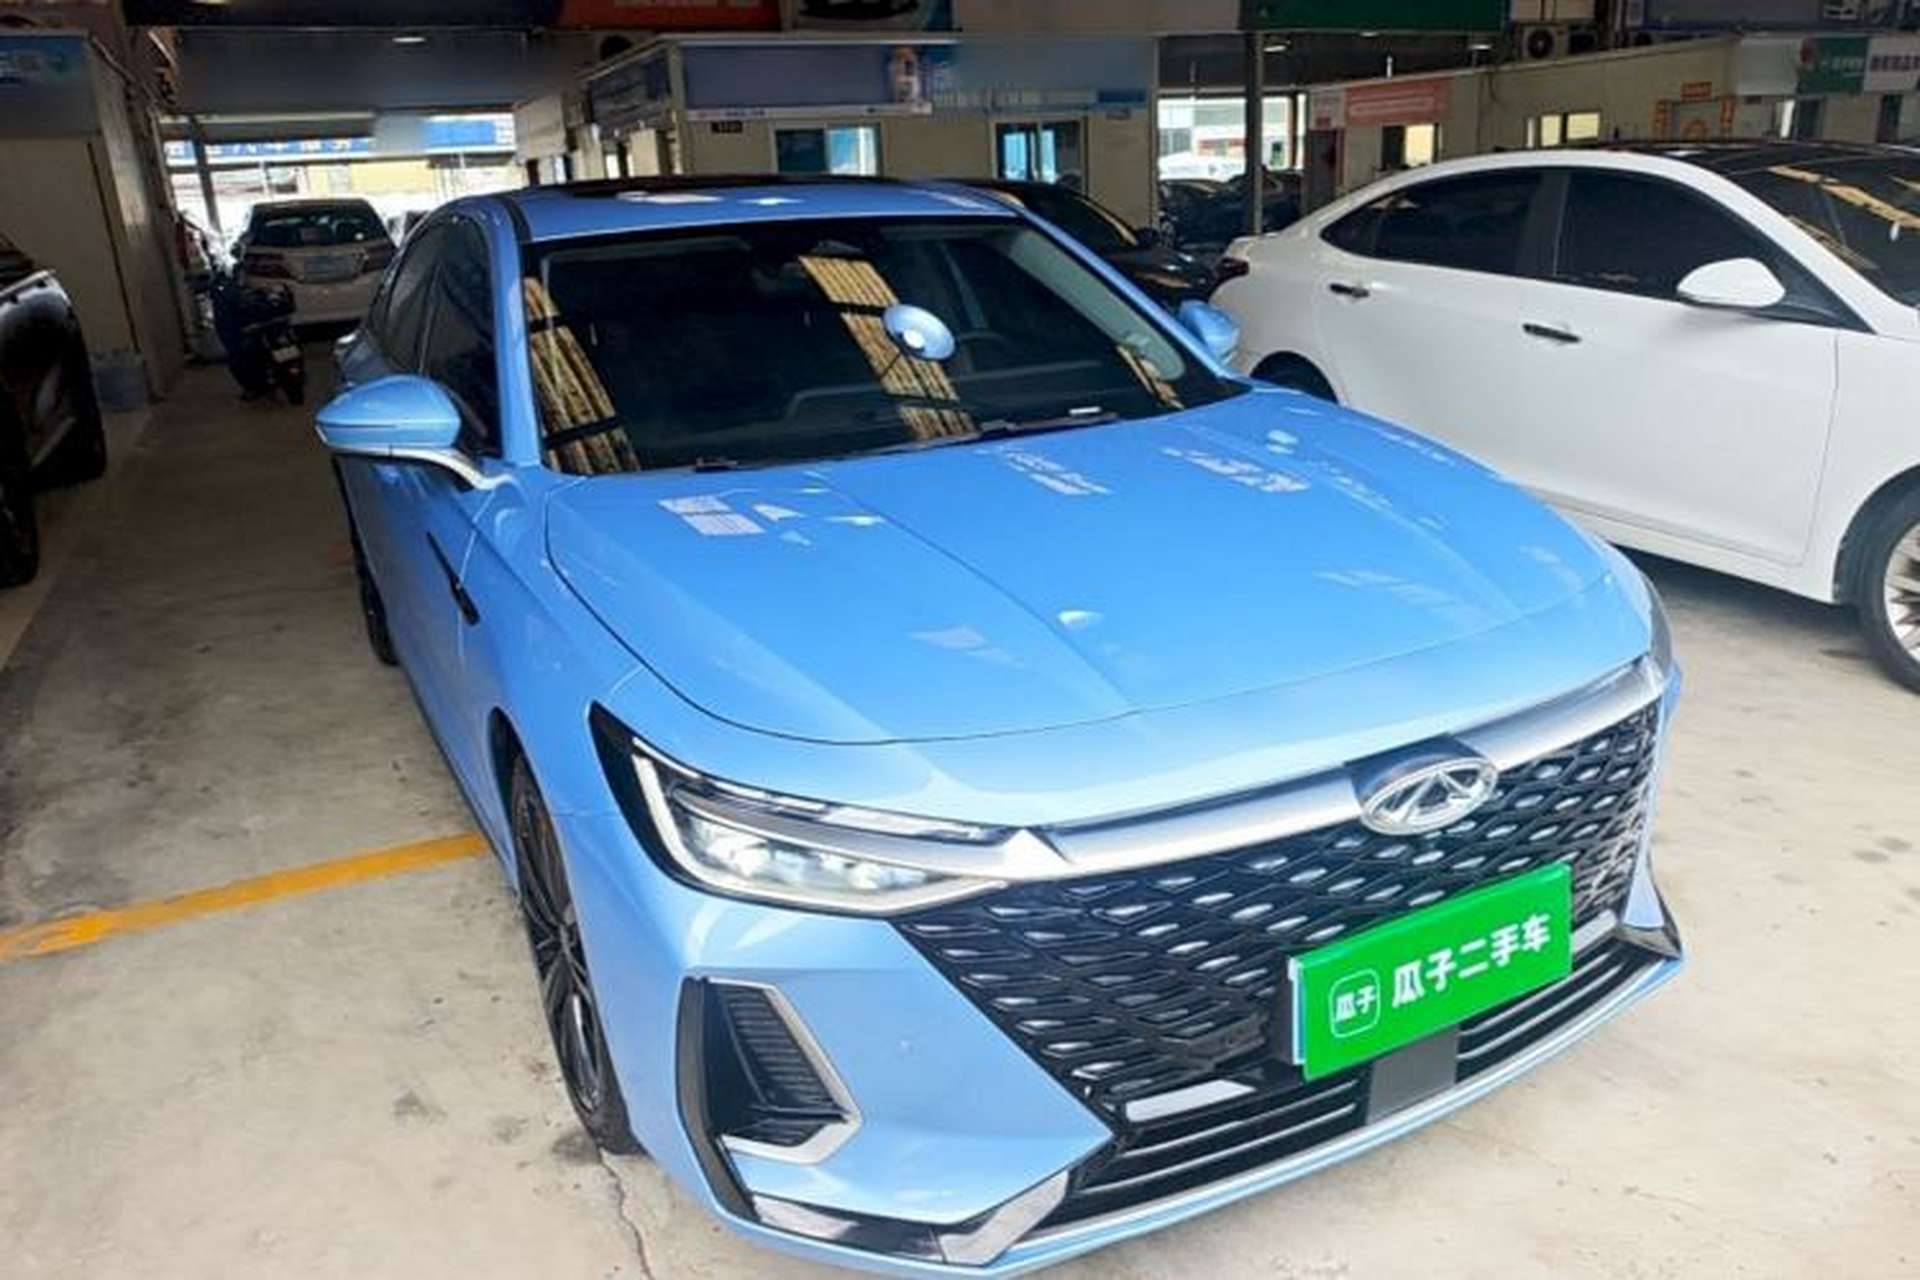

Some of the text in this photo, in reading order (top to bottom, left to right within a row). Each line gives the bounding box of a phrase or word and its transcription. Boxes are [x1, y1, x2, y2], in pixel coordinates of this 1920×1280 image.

[1392, 913, 1551, 1007] 瓜子二手车
[1336, 986, 1376, 1021] 瓜子
